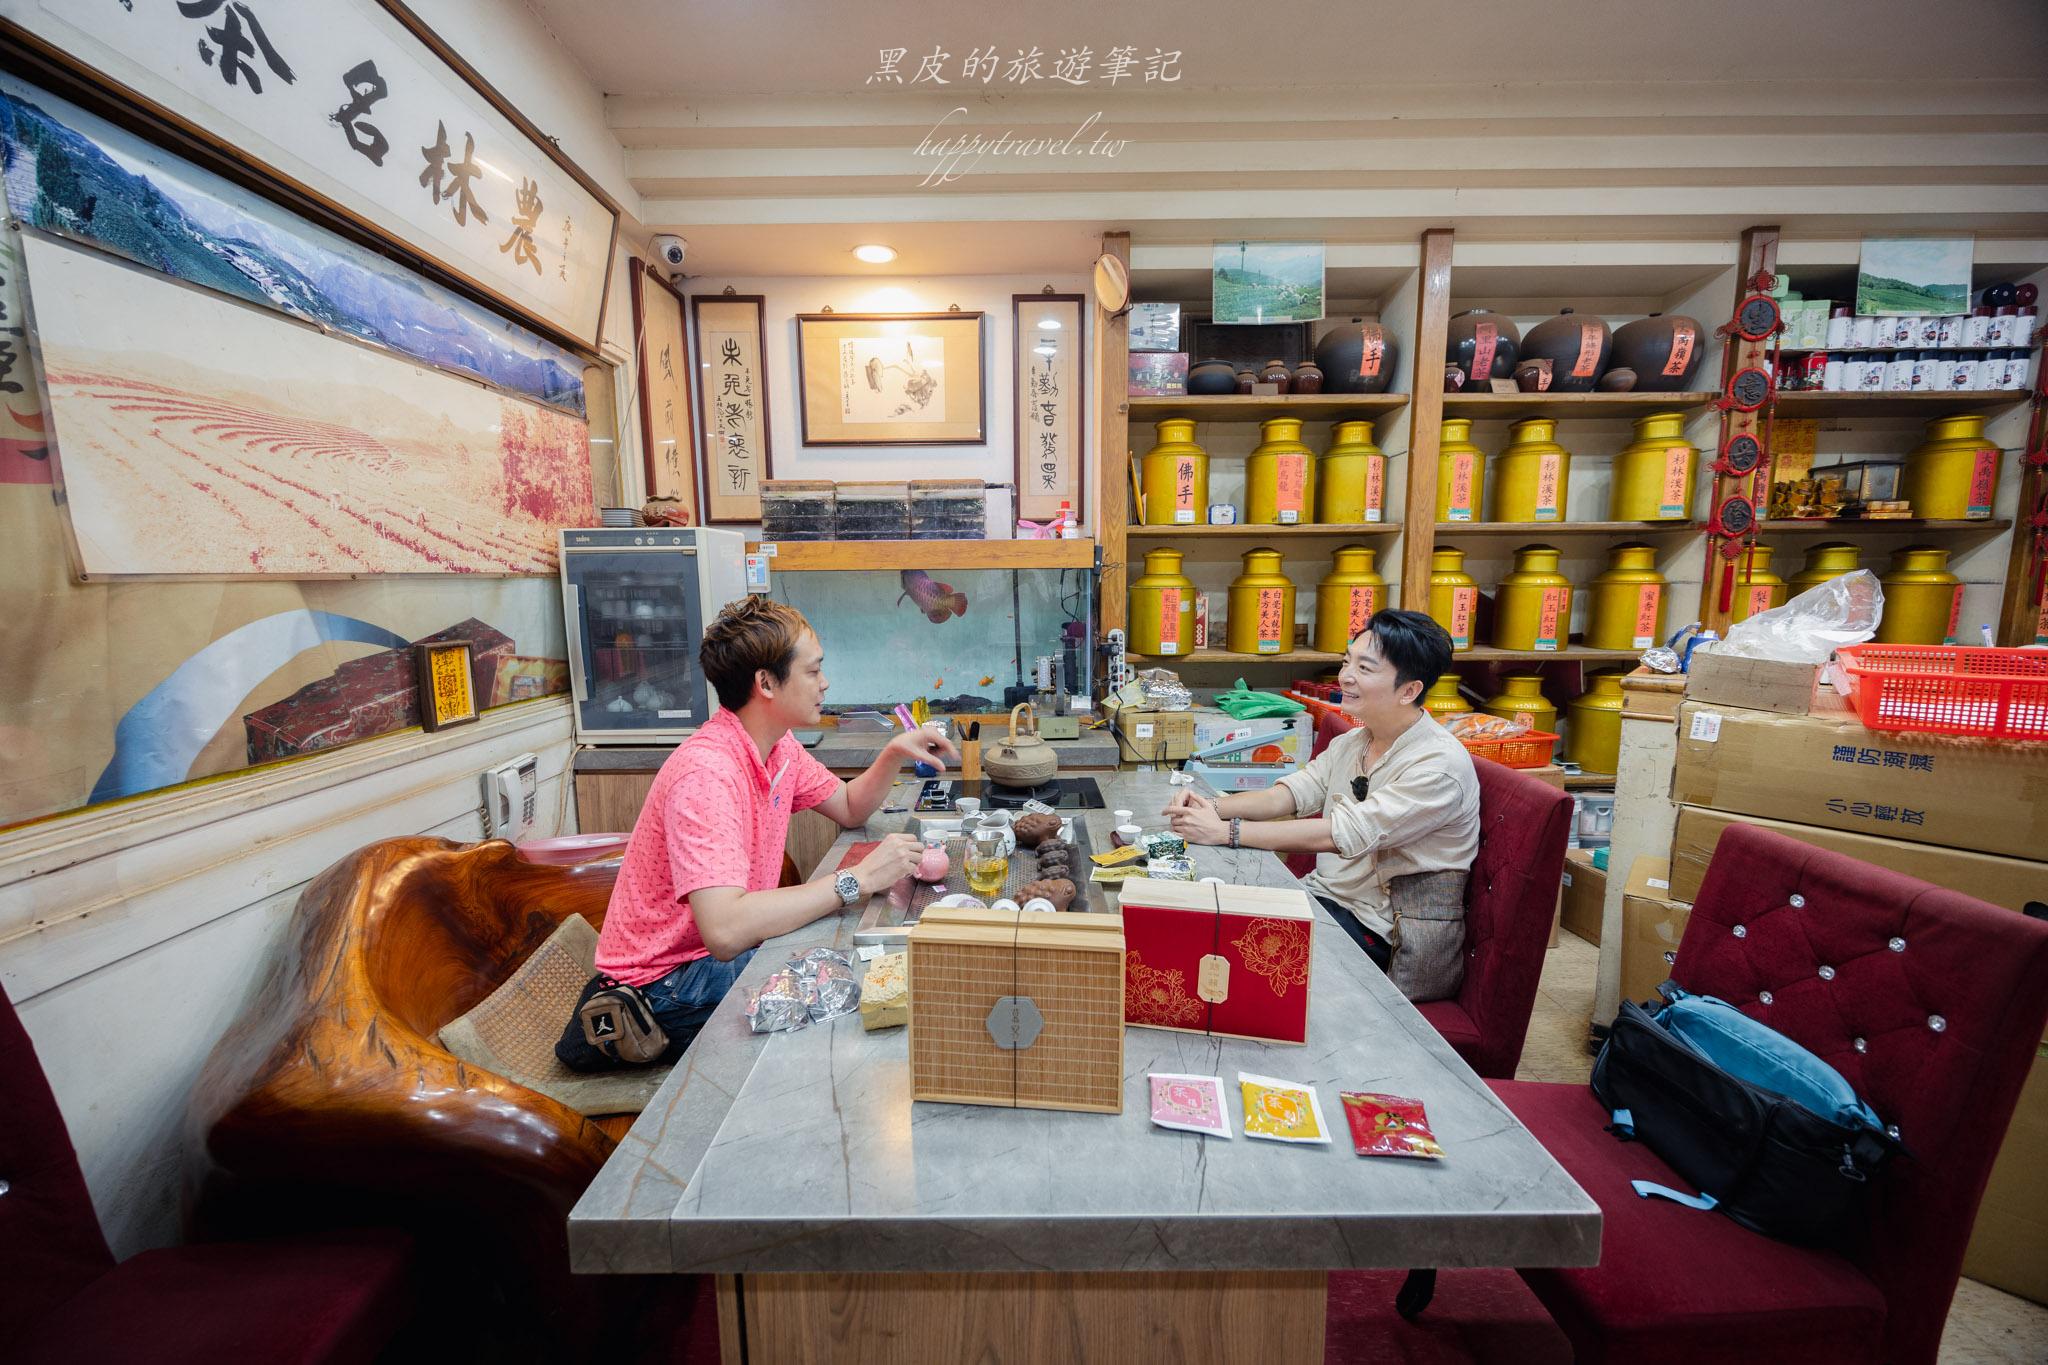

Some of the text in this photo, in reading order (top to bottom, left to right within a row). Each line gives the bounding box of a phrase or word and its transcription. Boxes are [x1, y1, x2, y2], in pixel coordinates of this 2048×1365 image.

[1178, 462, 1194, 504] 佛手
[1368, 461, 1381, 508] 杉林溪茶
[1259, 590, 1270, 638] 東方美人茶
[1271, 591, 1281, 638] 白毫烏龍茶
[1832, 744, 1935, 773] 謹防潮濕
[1825, 798, 1926, 826] 小心輕放
